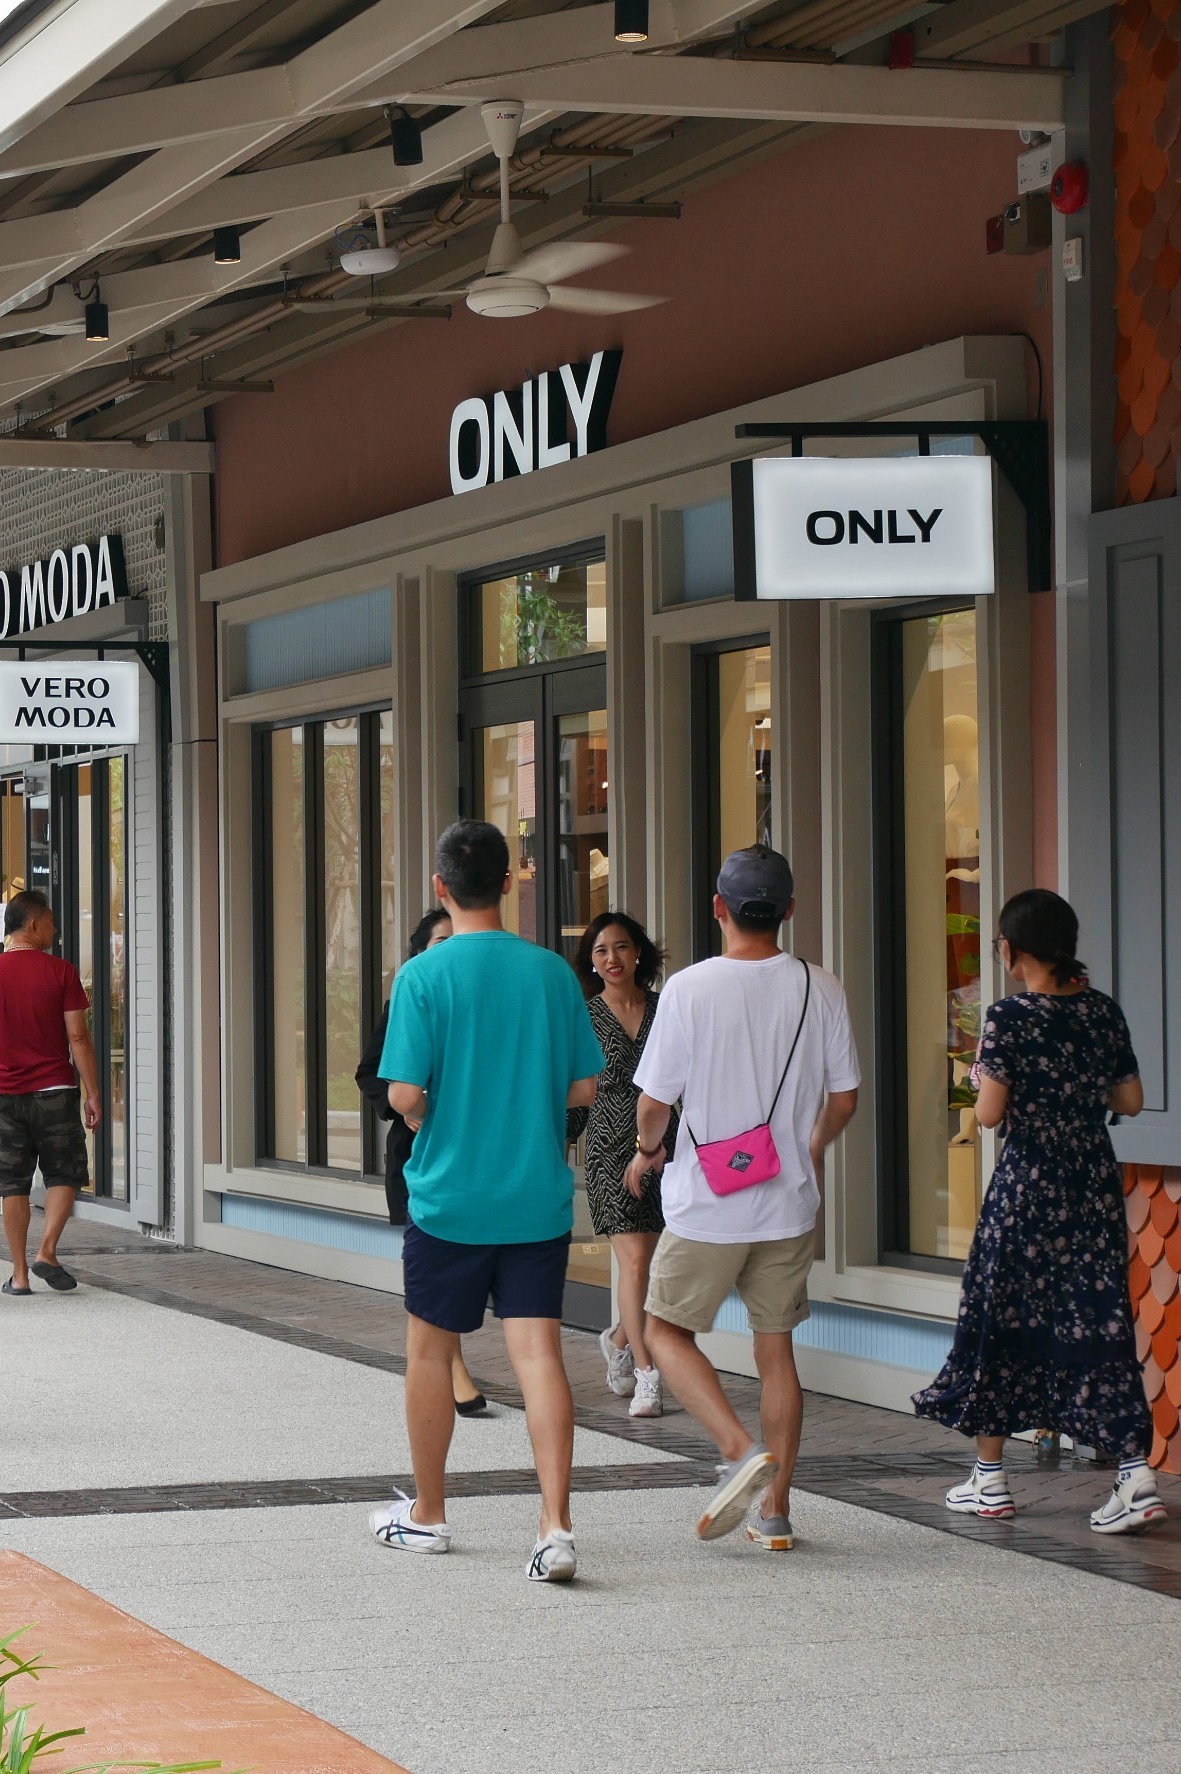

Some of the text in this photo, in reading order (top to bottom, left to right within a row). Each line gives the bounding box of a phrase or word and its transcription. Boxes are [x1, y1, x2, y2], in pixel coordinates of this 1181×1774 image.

[449, 350, 606, 495] ONLY
[805, 508, 944, 546] ONLY
[19, 535, 116, 634] MODA
[20, 677, 110, 699] VERO
[14, 706, 116, 728] MODA
[1120, 1471, 1132, 1481] 23
